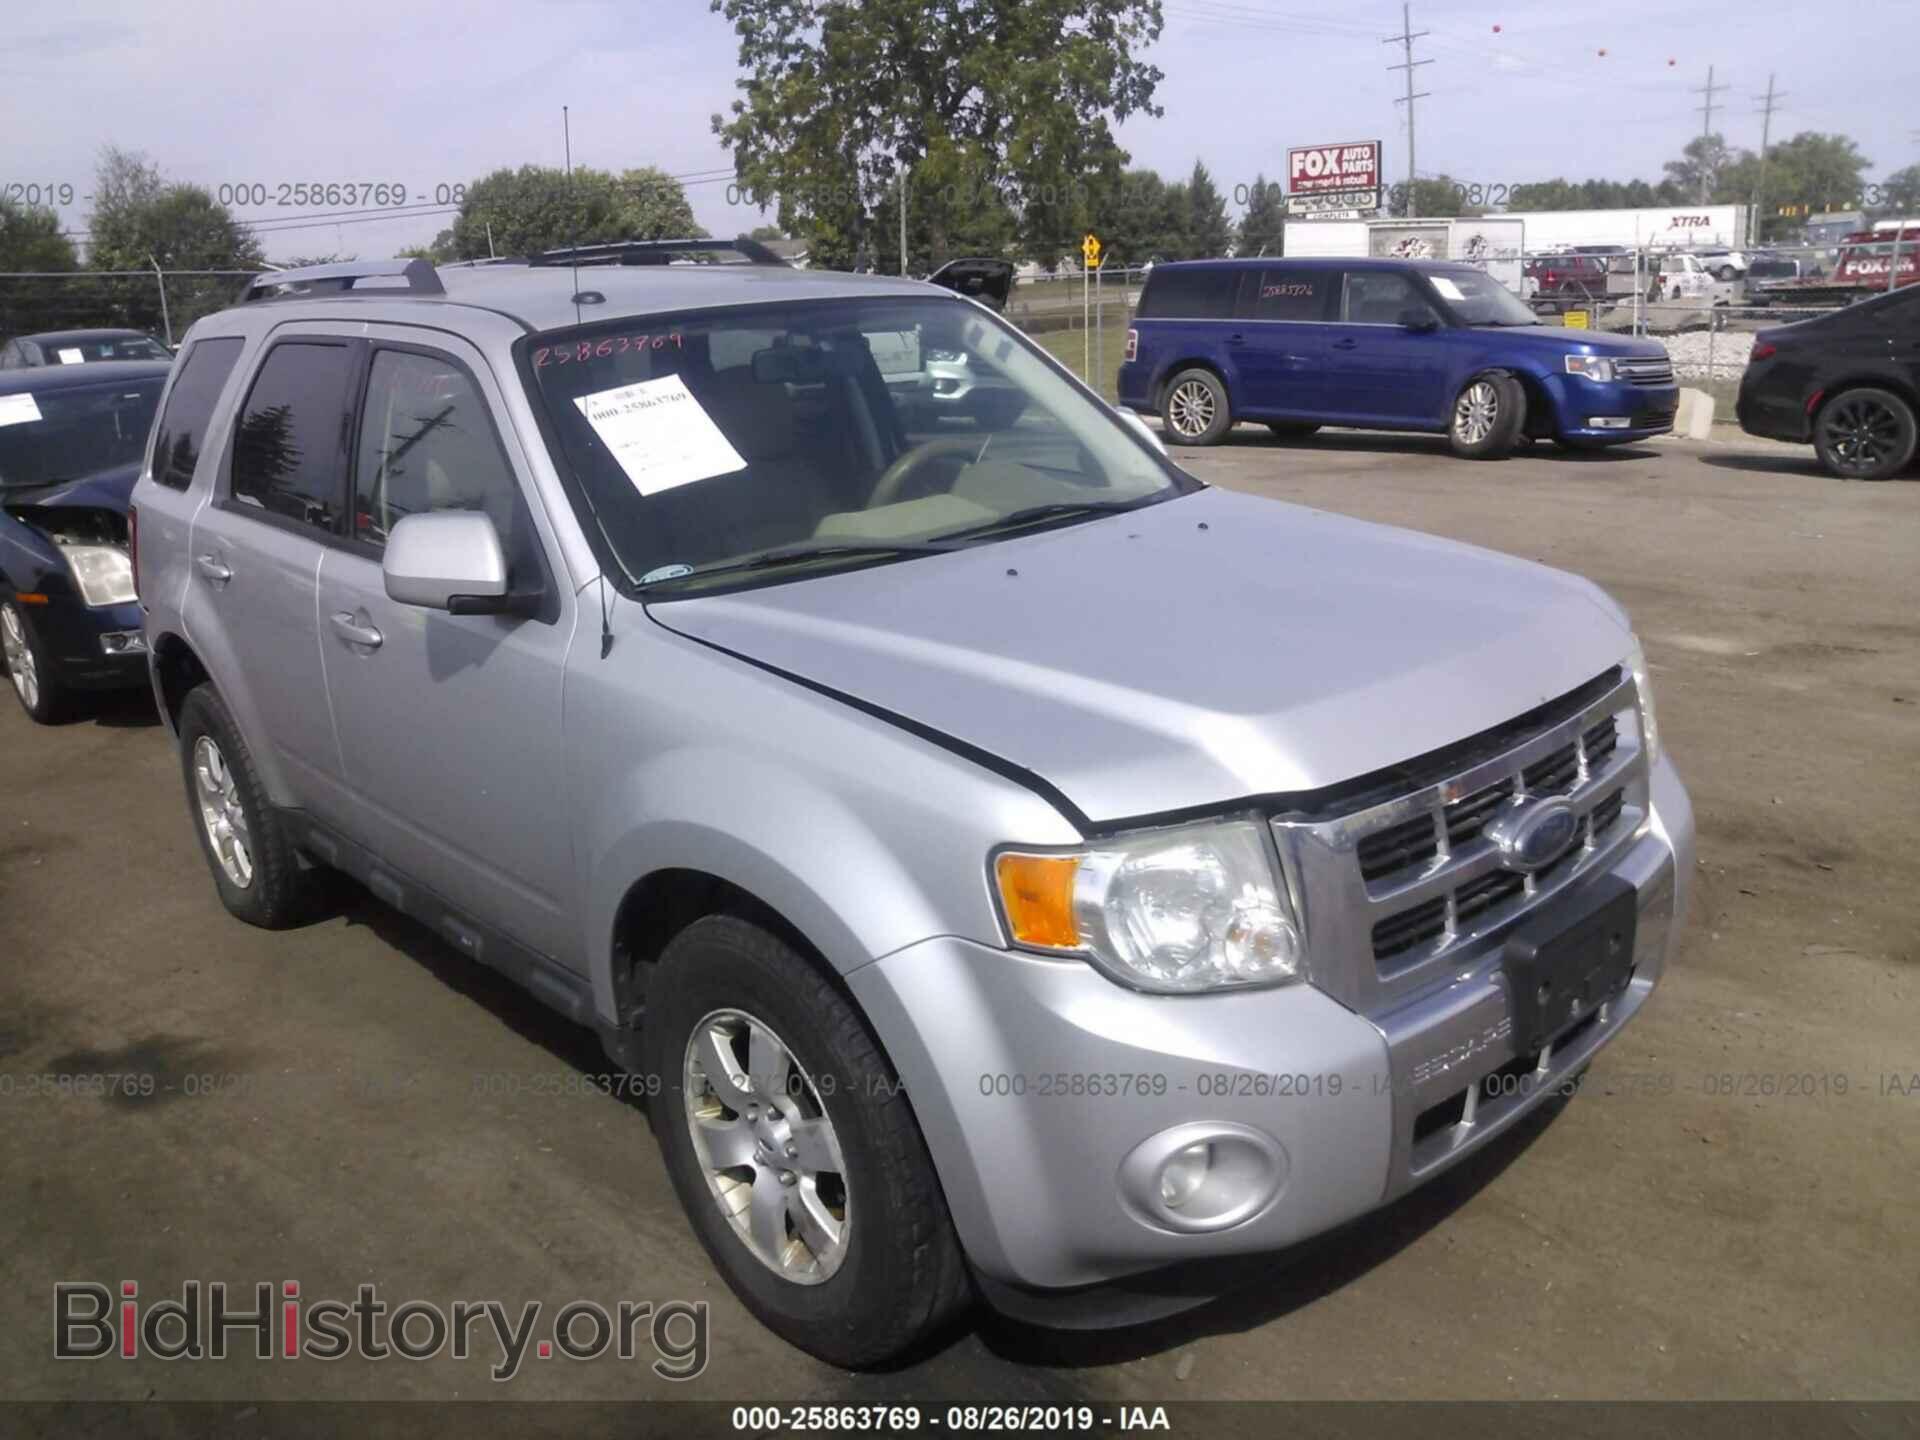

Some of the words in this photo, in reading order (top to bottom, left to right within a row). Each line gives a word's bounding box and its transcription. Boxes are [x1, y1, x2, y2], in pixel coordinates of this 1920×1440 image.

[1342, 147, 1370, 160] AUTO
[1291, 150, 1340, 178] FOX
[1342, 160, 1374, 174] PARTS
[1667, 215, 1711, 231] XTRA
[1845, 258, 1884, 275] FOX
